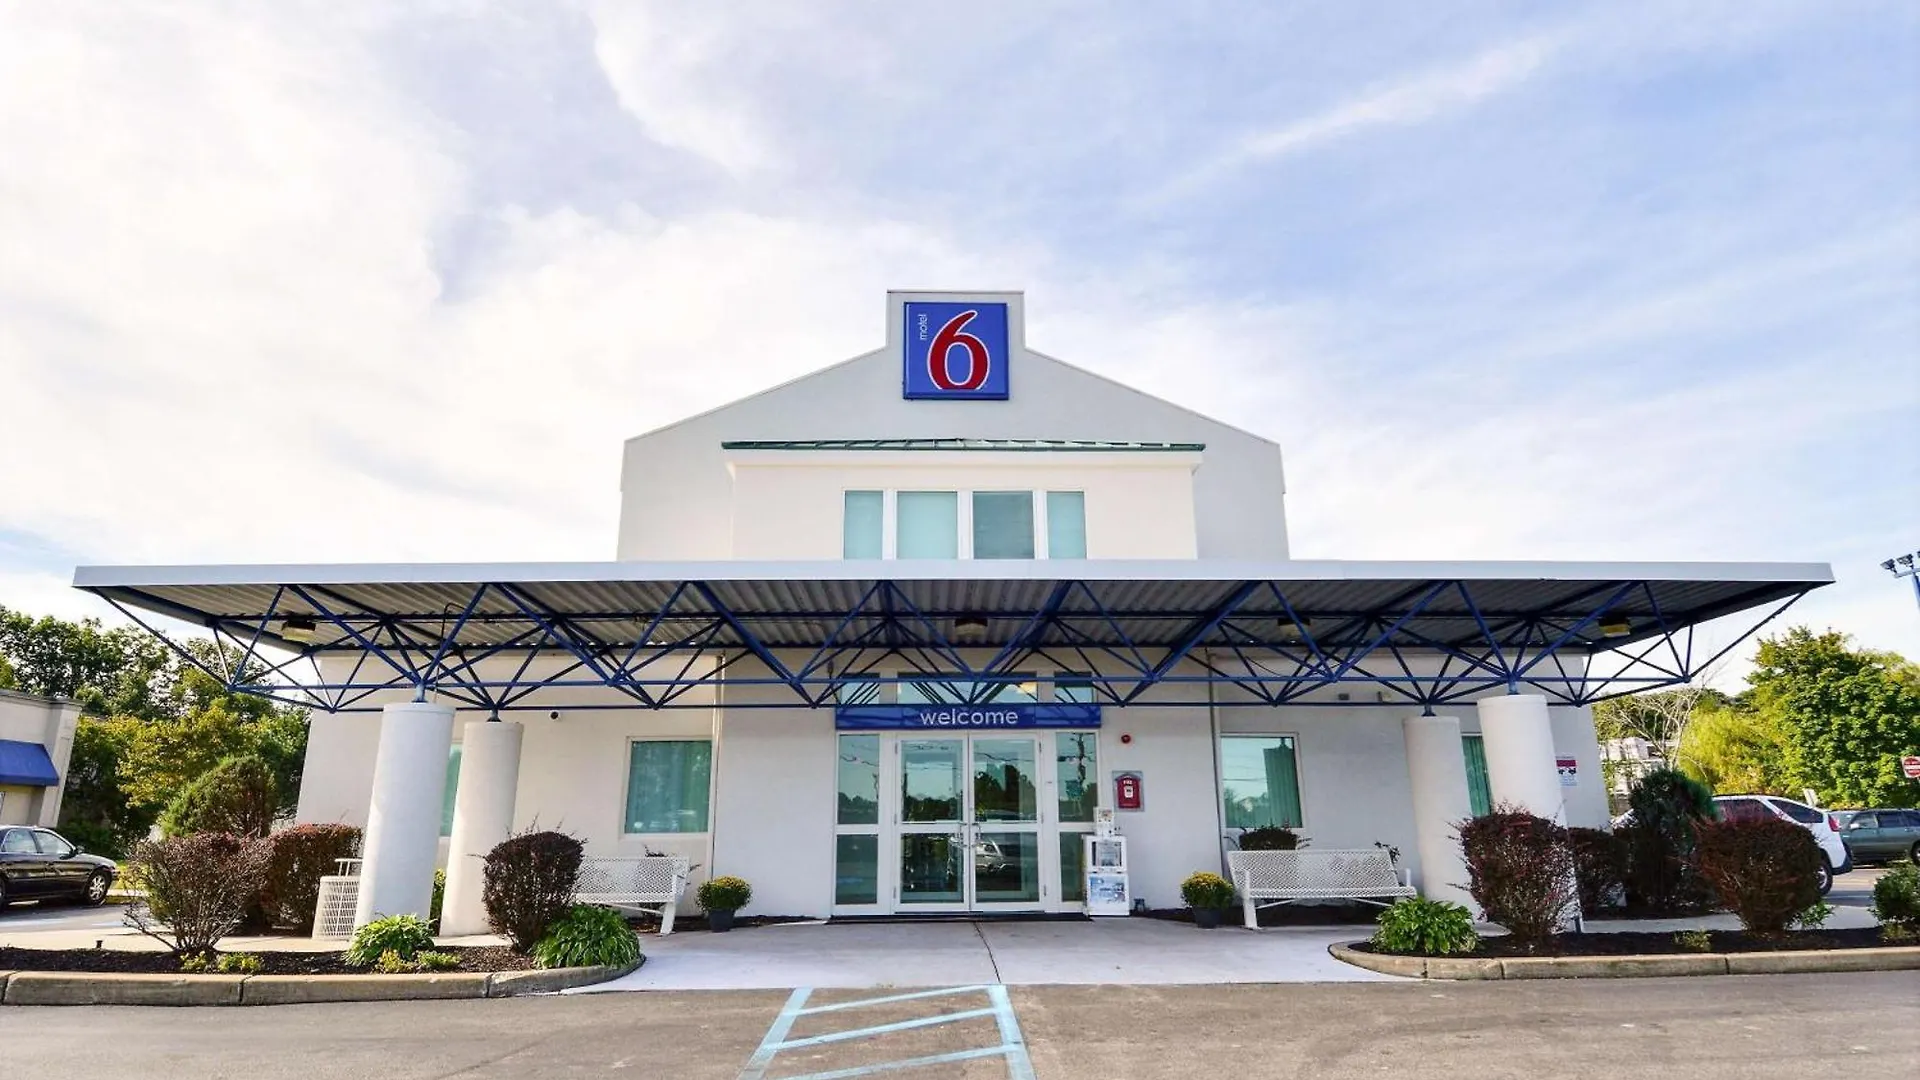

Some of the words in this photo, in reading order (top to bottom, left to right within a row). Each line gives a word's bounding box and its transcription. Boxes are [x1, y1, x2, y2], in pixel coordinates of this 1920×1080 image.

[918, 313, 928, 340] motel
[927, 310, 990, 390] 6
[920, 708, 1018, 725] welcome
